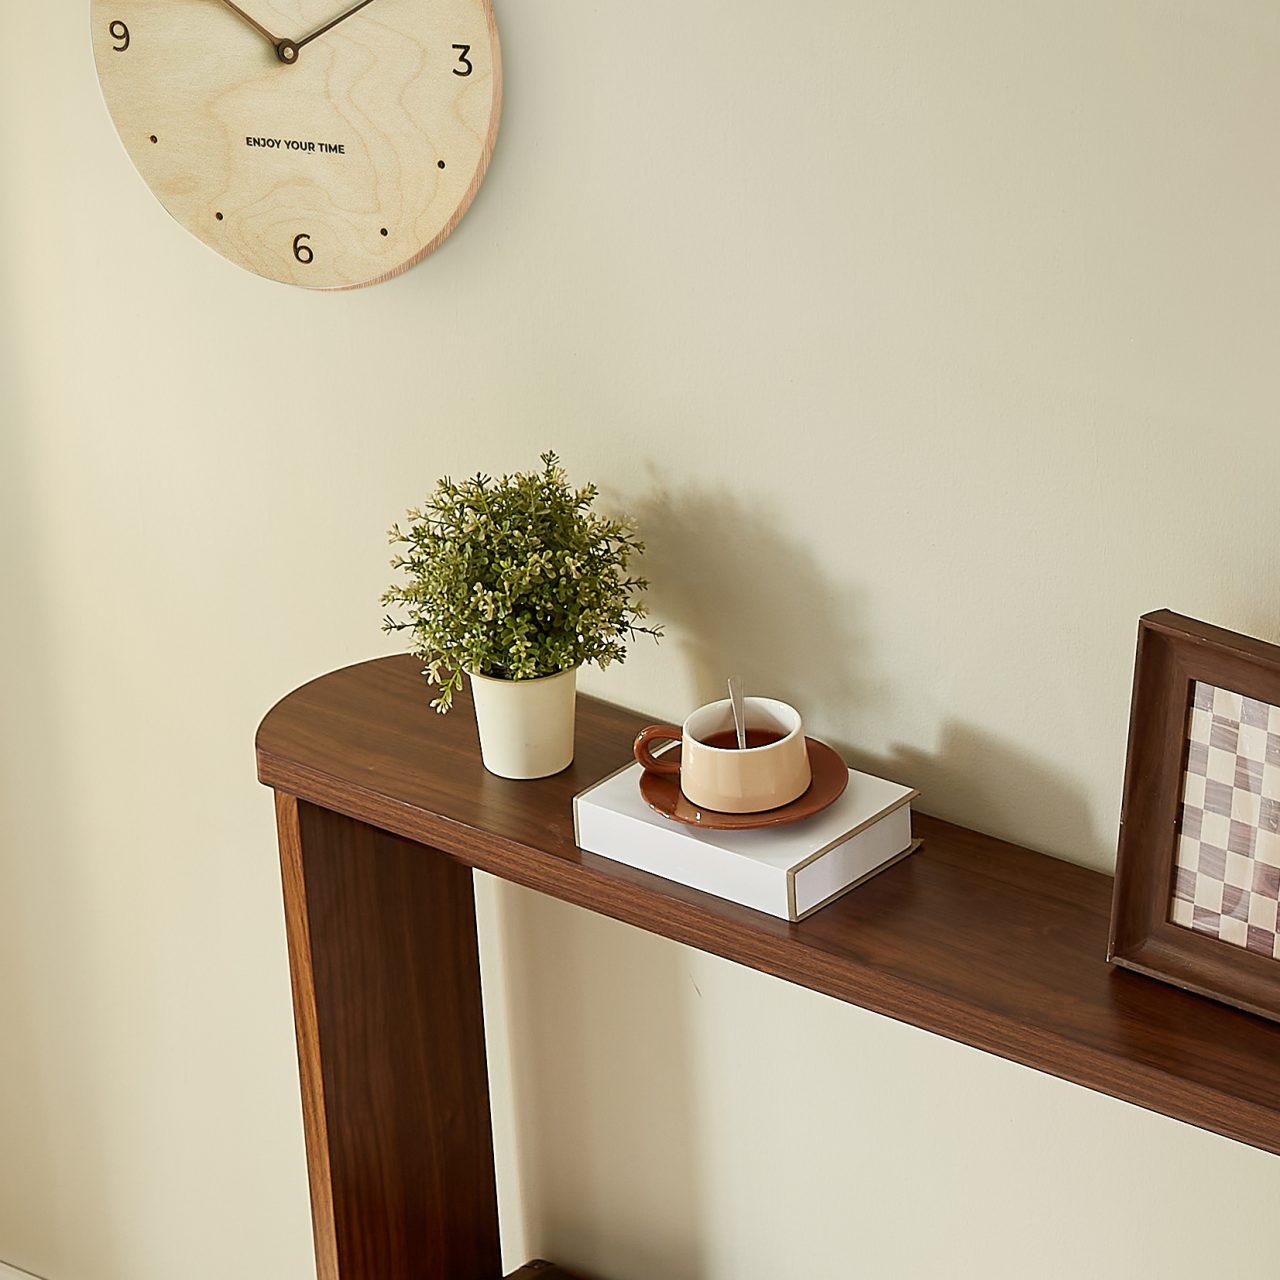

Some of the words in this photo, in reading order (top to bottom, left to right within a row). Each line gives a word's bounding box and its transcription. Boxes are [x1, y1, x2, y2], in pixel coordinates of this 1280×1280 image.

[108, 20, 131, 53] 9
[451, 43, 474, 77] 3
[245, 136, 281, 149] ENJOY
[283, 139, 316, 152] YOUR
[317, 142, 346, 155] TIME
[292, 233, 315, 265] 6
